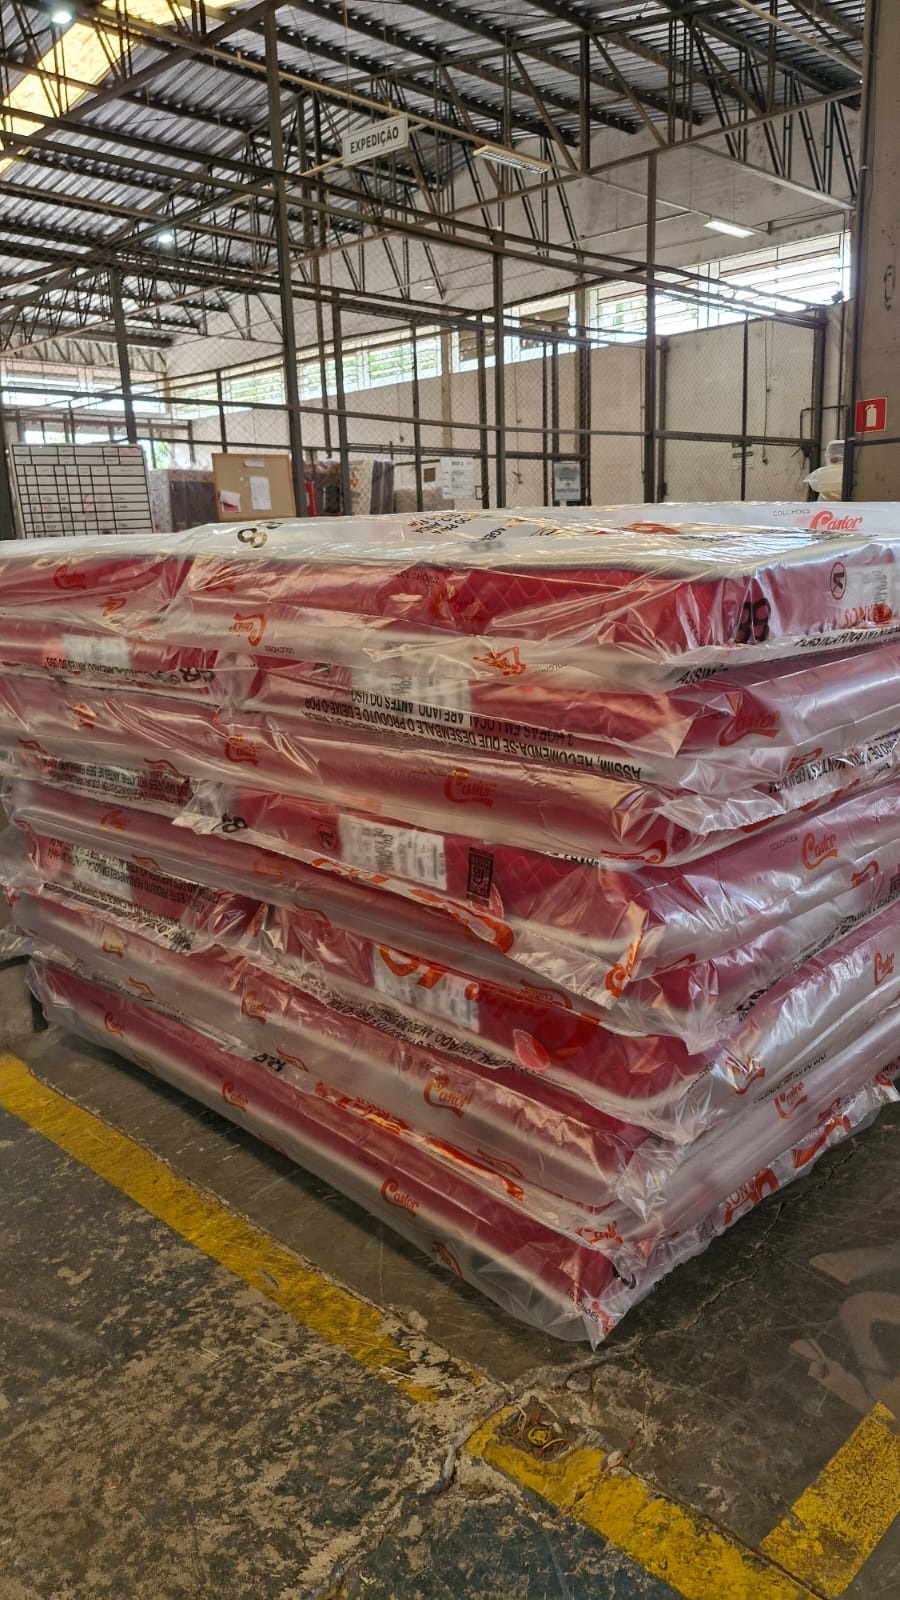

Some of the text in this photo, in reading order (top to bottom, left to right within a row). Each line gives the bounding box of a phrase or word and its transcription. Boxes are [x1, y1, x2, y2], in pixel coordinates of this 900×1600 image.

[350, 126, 399, 154] EXPEDIÇÃO
[810, 510, 863, 531] Castor
[304, 696, 642, 780] ASSIM, RECOMENDA-SE QUE DESEMBALE O PRODUTO E DEIXE-O POR
[801, 832, 838, 870] Castor
[380, 1177, 420, 1217] Castor
